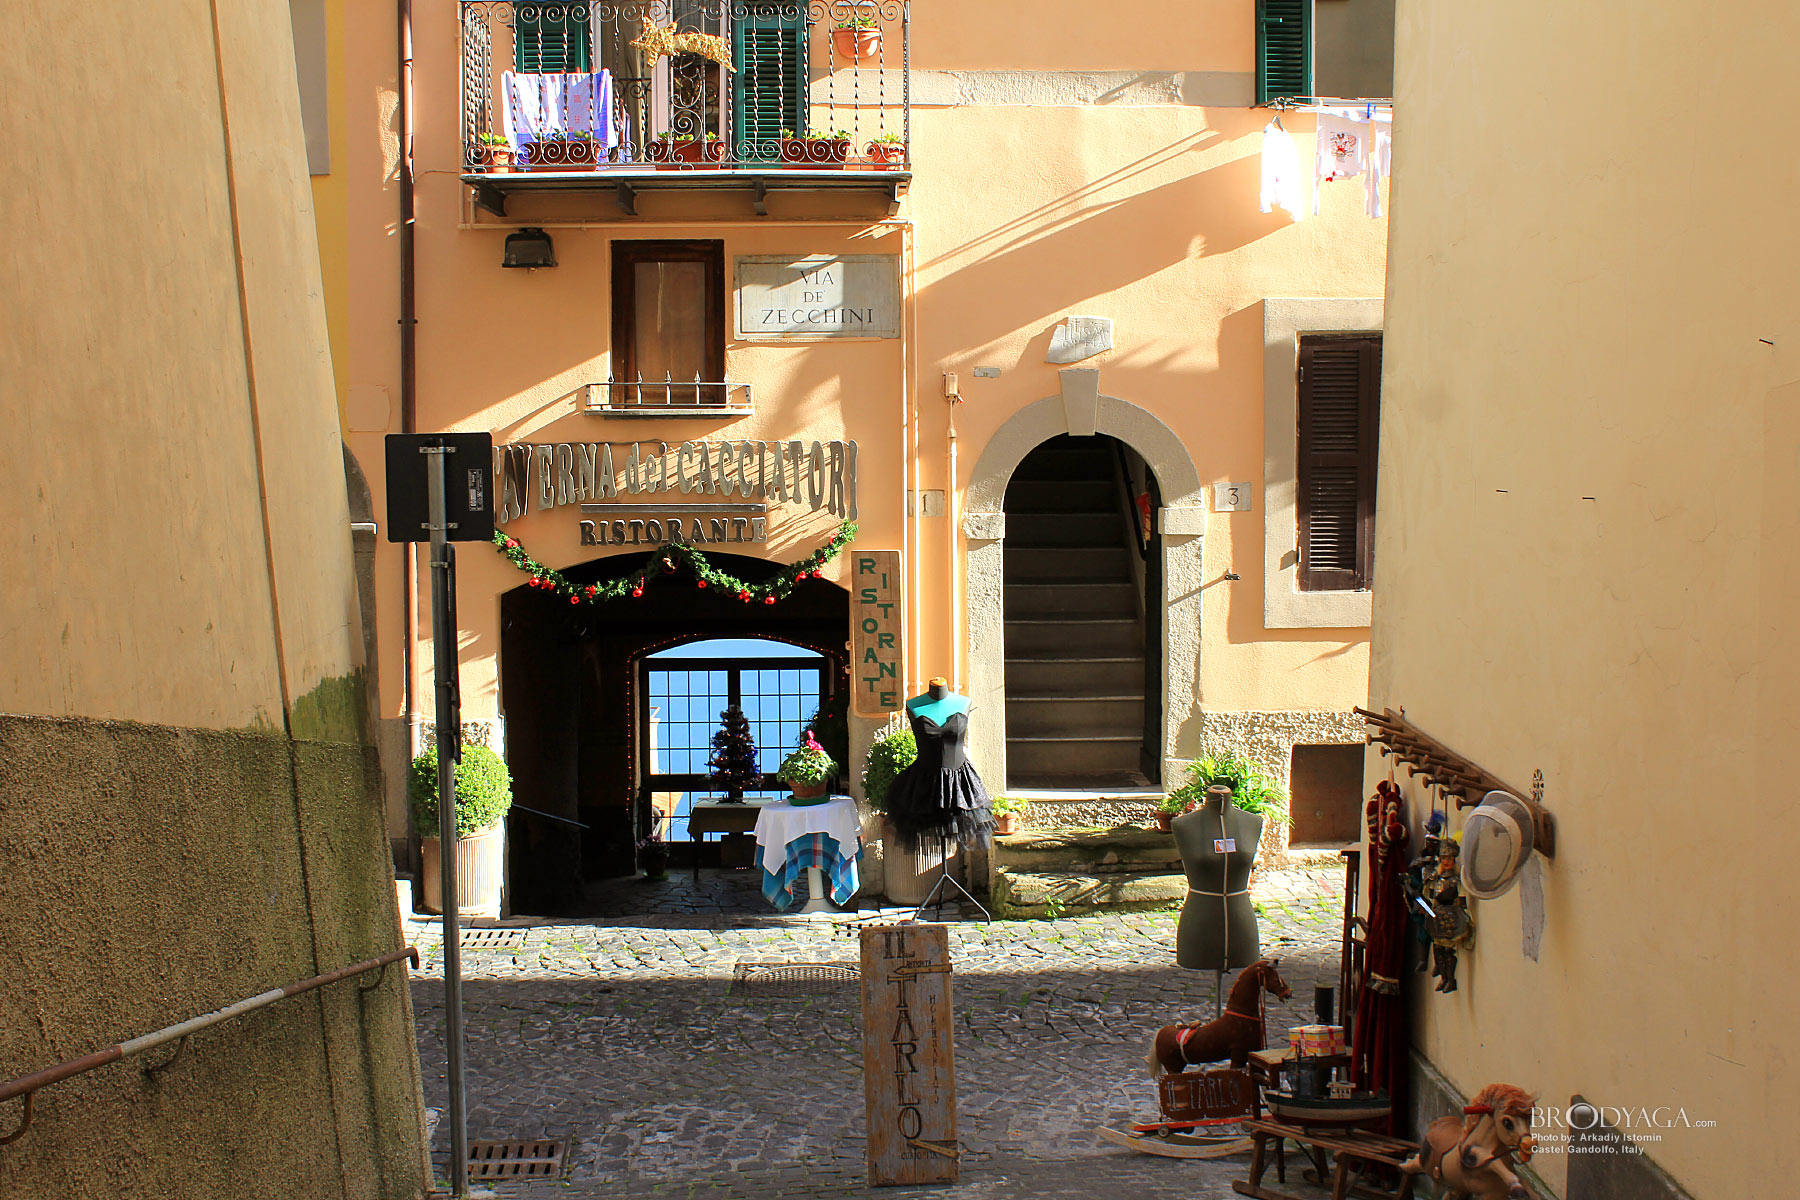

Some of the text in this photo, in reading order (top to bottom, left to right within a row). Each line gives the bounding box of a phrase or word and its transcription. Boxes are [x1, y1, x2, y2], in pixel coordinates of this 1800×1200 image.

[800, 271, 834, 285] VIA
[761, 308, 873, 325] ZECCHINI
[493, 442, 618, 524] AVERNA
[625, 442, 668, 494] dei
[677, 439, 858, 521] CACCIATORI
[1227, 487, 1239, 506] 3
[579, 516, 768, 546] RISTORANTE
[858, 558, 897, 707] RISTORANTE
[883, 931, 916, 960] IL
[886, 975, 923, 1140] TARLO
[1166, 1077, 1241, 1112] IL TARLO
